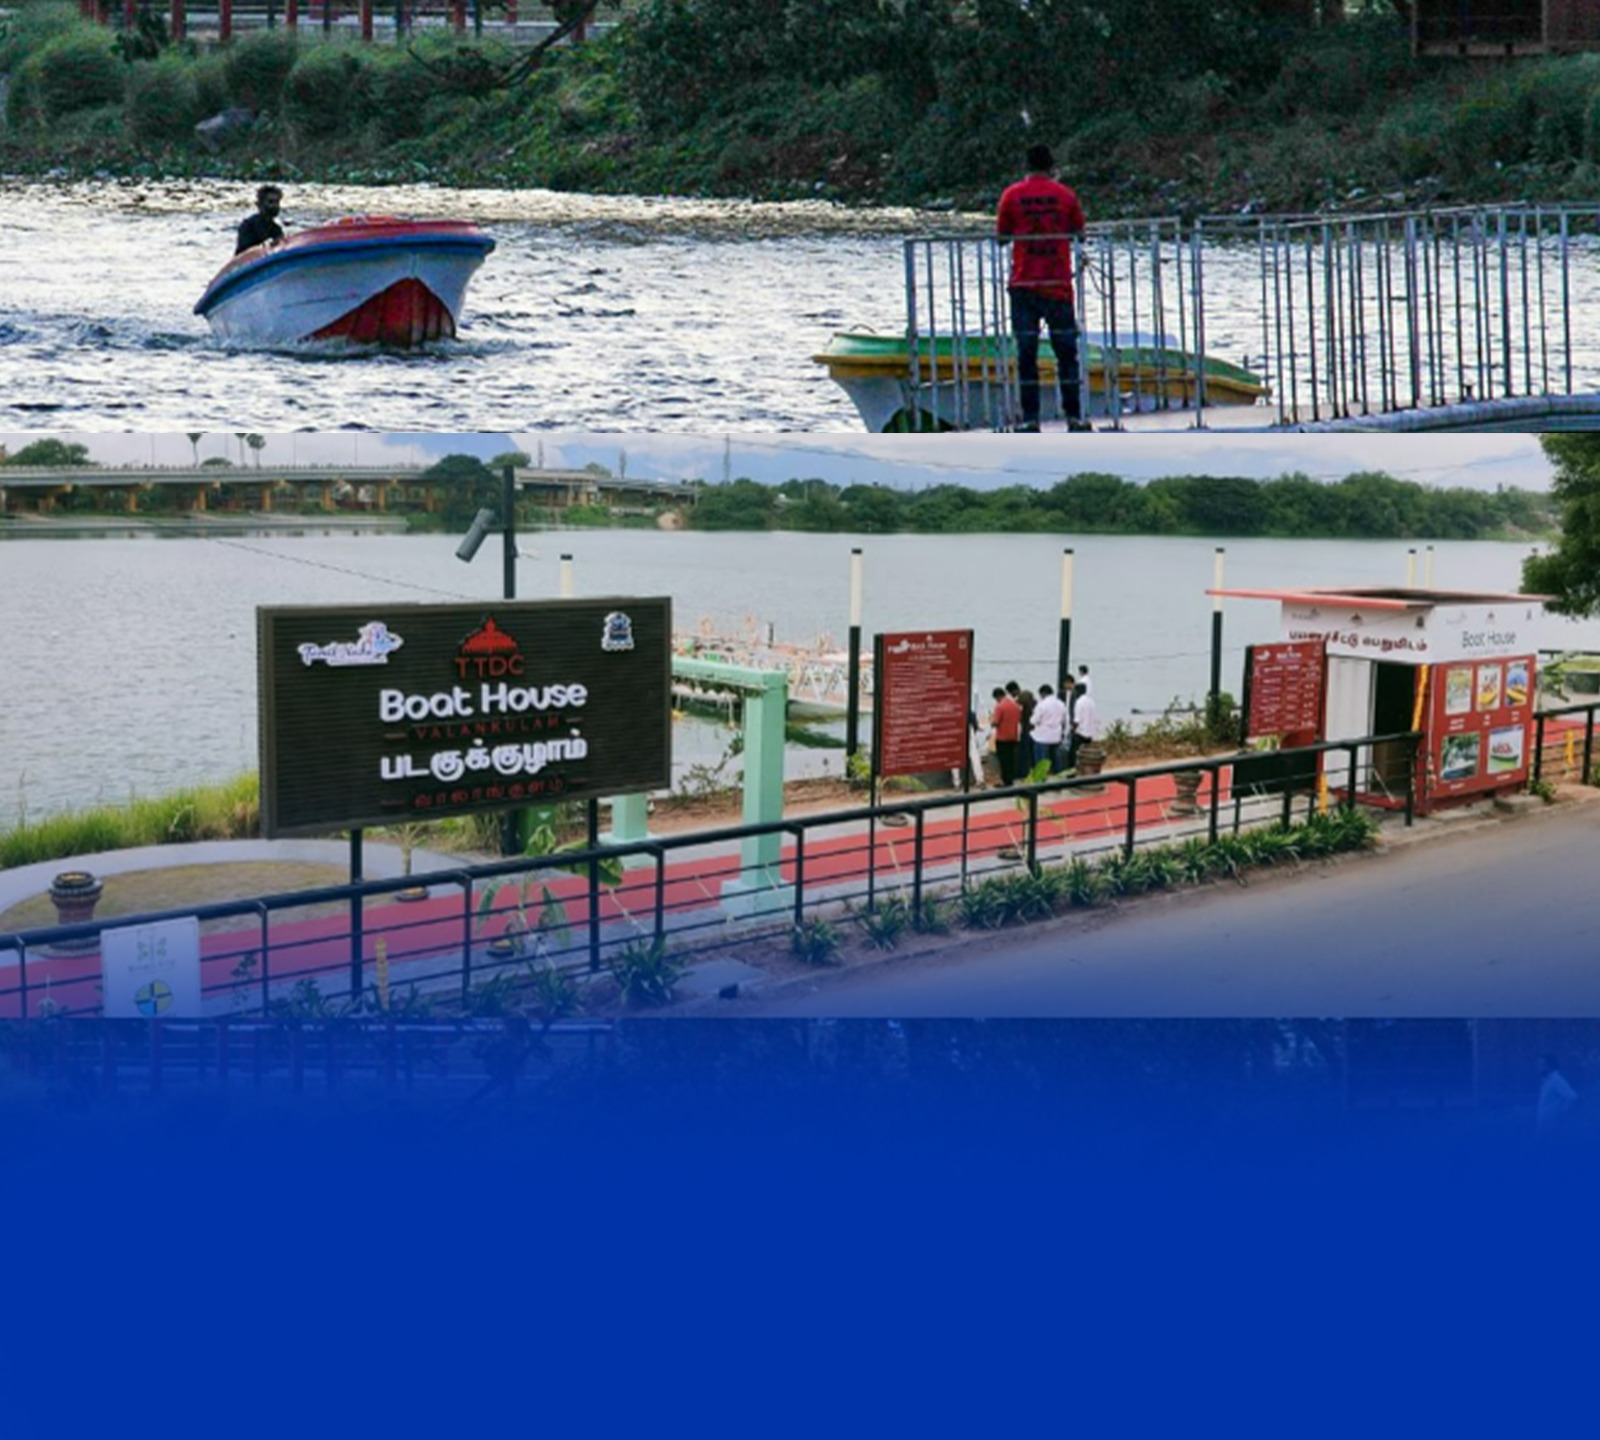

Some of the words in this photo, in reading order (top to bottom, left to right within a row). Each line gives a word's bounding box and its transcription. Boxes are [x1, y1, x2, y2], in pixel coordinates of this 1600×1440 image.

[1462, 630, 1485, 648] Boat
[1487, 627, 1516, 646] House
[454, 654, 525, 679] TTDC
[379, 685, 474, 722] Boat
[480, 681, 588, 713] House
[414, 714, 560, 739] VALANKULAM
[379, 728, 588, 782] படகுக்குழாம்
